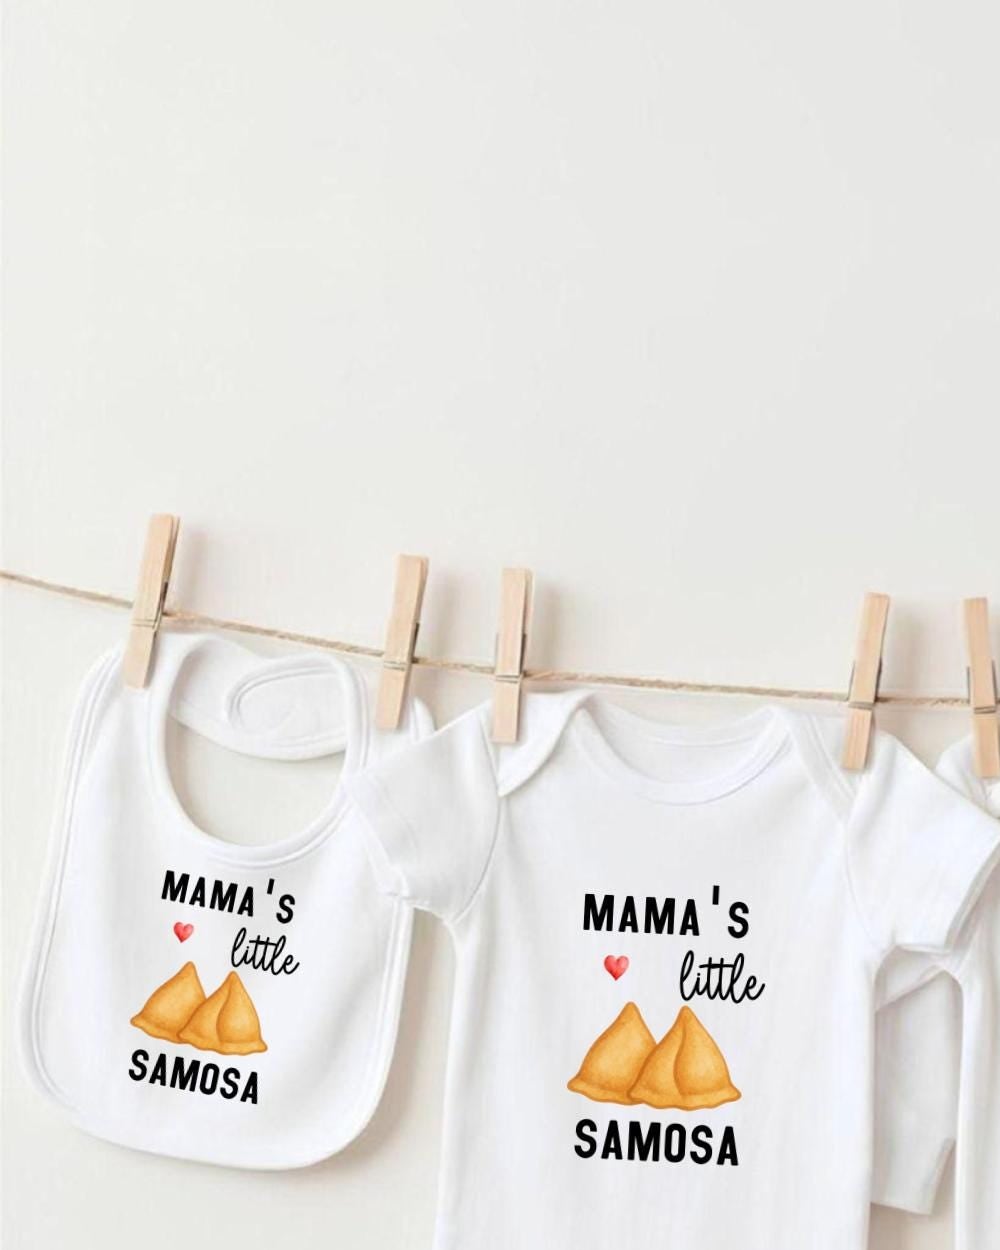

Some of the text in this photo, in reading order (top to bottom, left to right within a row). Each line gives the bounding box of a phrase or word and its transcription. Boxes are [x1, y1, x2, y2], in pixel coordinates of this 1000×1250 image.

[161, 870, 295, 924] MAMA'S
[583, 885, 749, 938] MAMA'S
[231, 927, 300, 975] little
[680, 950, 765, 1004] little
[129, 1049, 257, 1104] SAMOSA
[574, 1119, 738, 1166] SAMOSA
